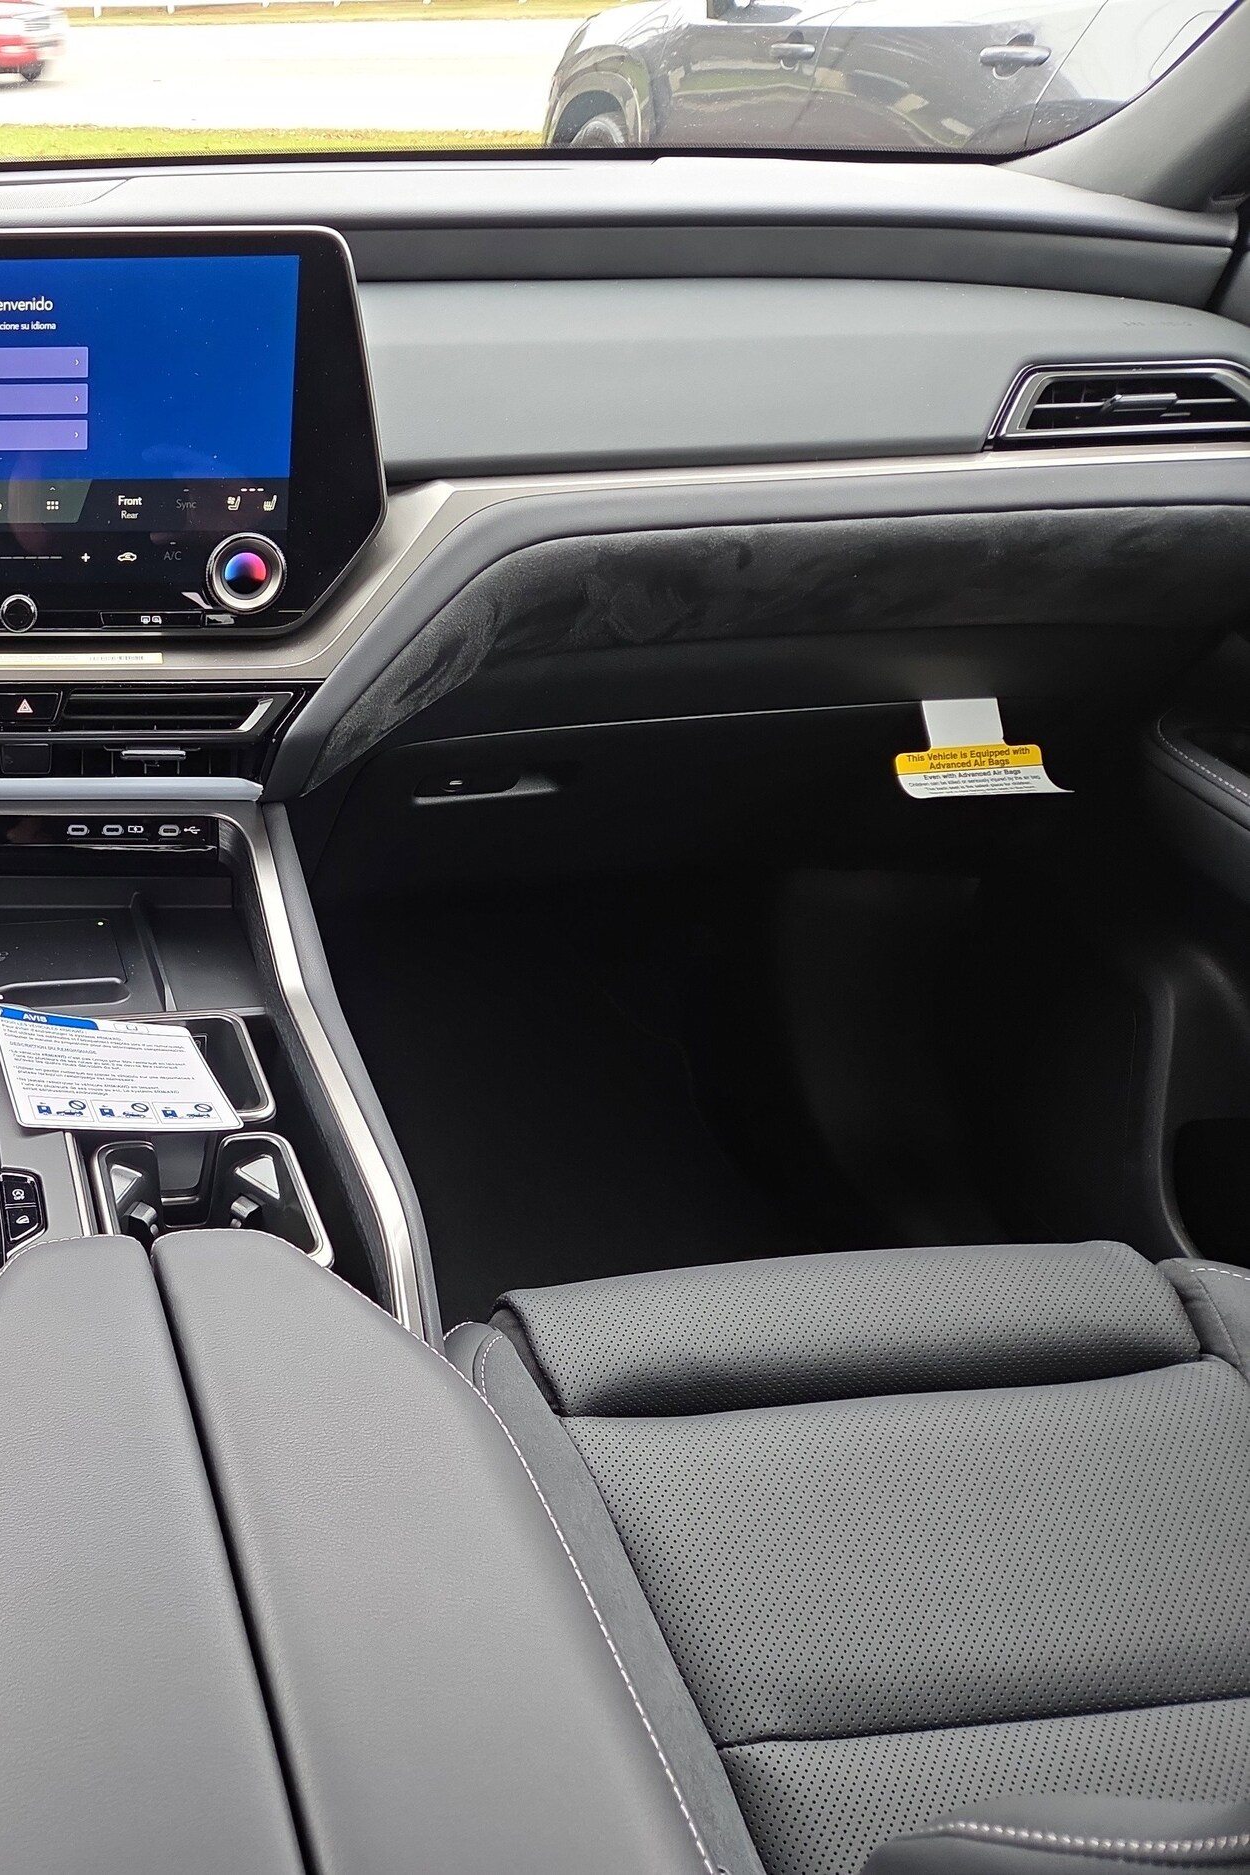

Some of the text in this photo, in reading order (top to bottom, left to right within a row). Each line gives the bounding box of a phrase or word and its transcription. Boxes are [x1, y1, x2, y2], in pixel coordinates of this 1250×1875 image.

[31, 321, 56, 330] idioma
[118, 495, 143, 505] Front
[176, 499, 197, 511] Sync
[121, 510, 139, 519] Rear
[164, 551, 182, 561] A/C
[907, 746, 1030, 762] This Vehicle is Equipped with
[930, 758, 1010, 770] Advanced Air Bags
[958, 770, 992, 778] Advanced
[22, 1013, 48, 1023] AVIS
